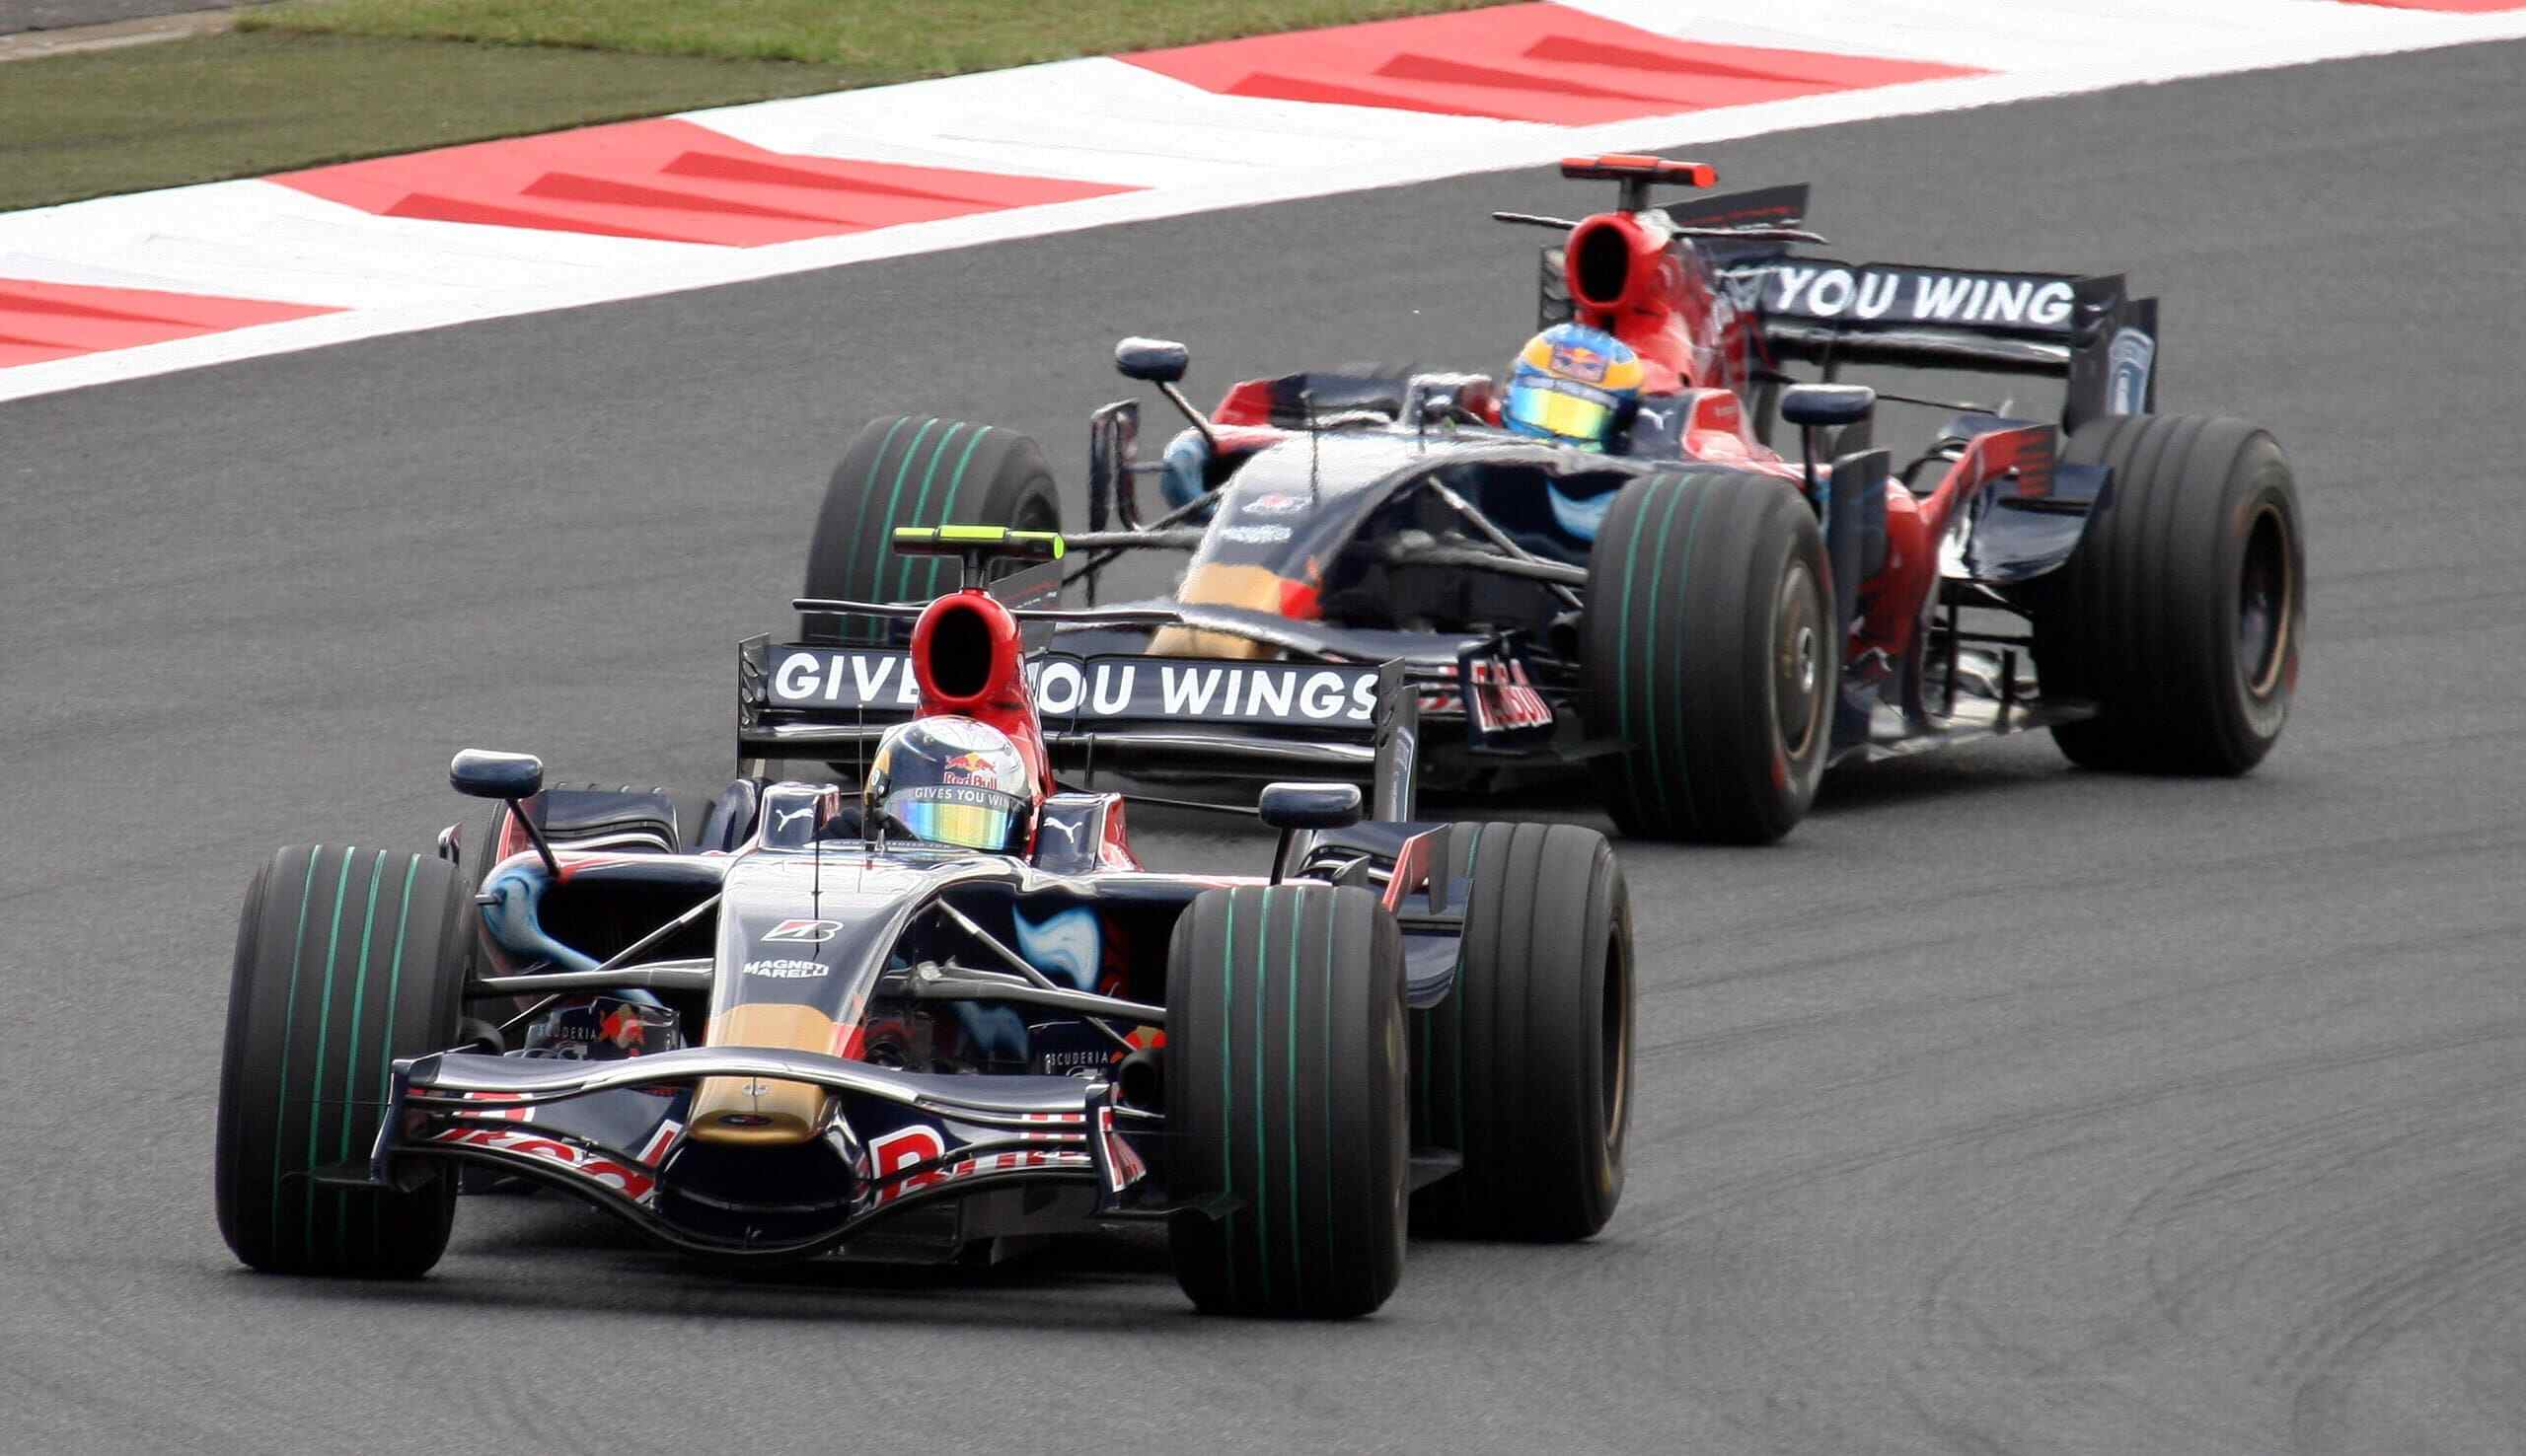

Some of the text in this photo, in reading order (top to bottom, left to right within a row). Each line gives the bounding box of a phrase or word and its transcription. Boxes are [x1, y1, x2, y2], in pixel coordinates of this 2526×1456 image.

[1776, 265, 1900, 320] YOU
[1911, 275, 2074, 325] WING
[775, 652, 920, 703] GIVE
[1160, 666, 1379, 720] WINGS
[915, 787, 953, 800] GIVES
[957, 789, 985, 803] YOU
[1050, 1051, 1109, 1066] SCUDERIA
